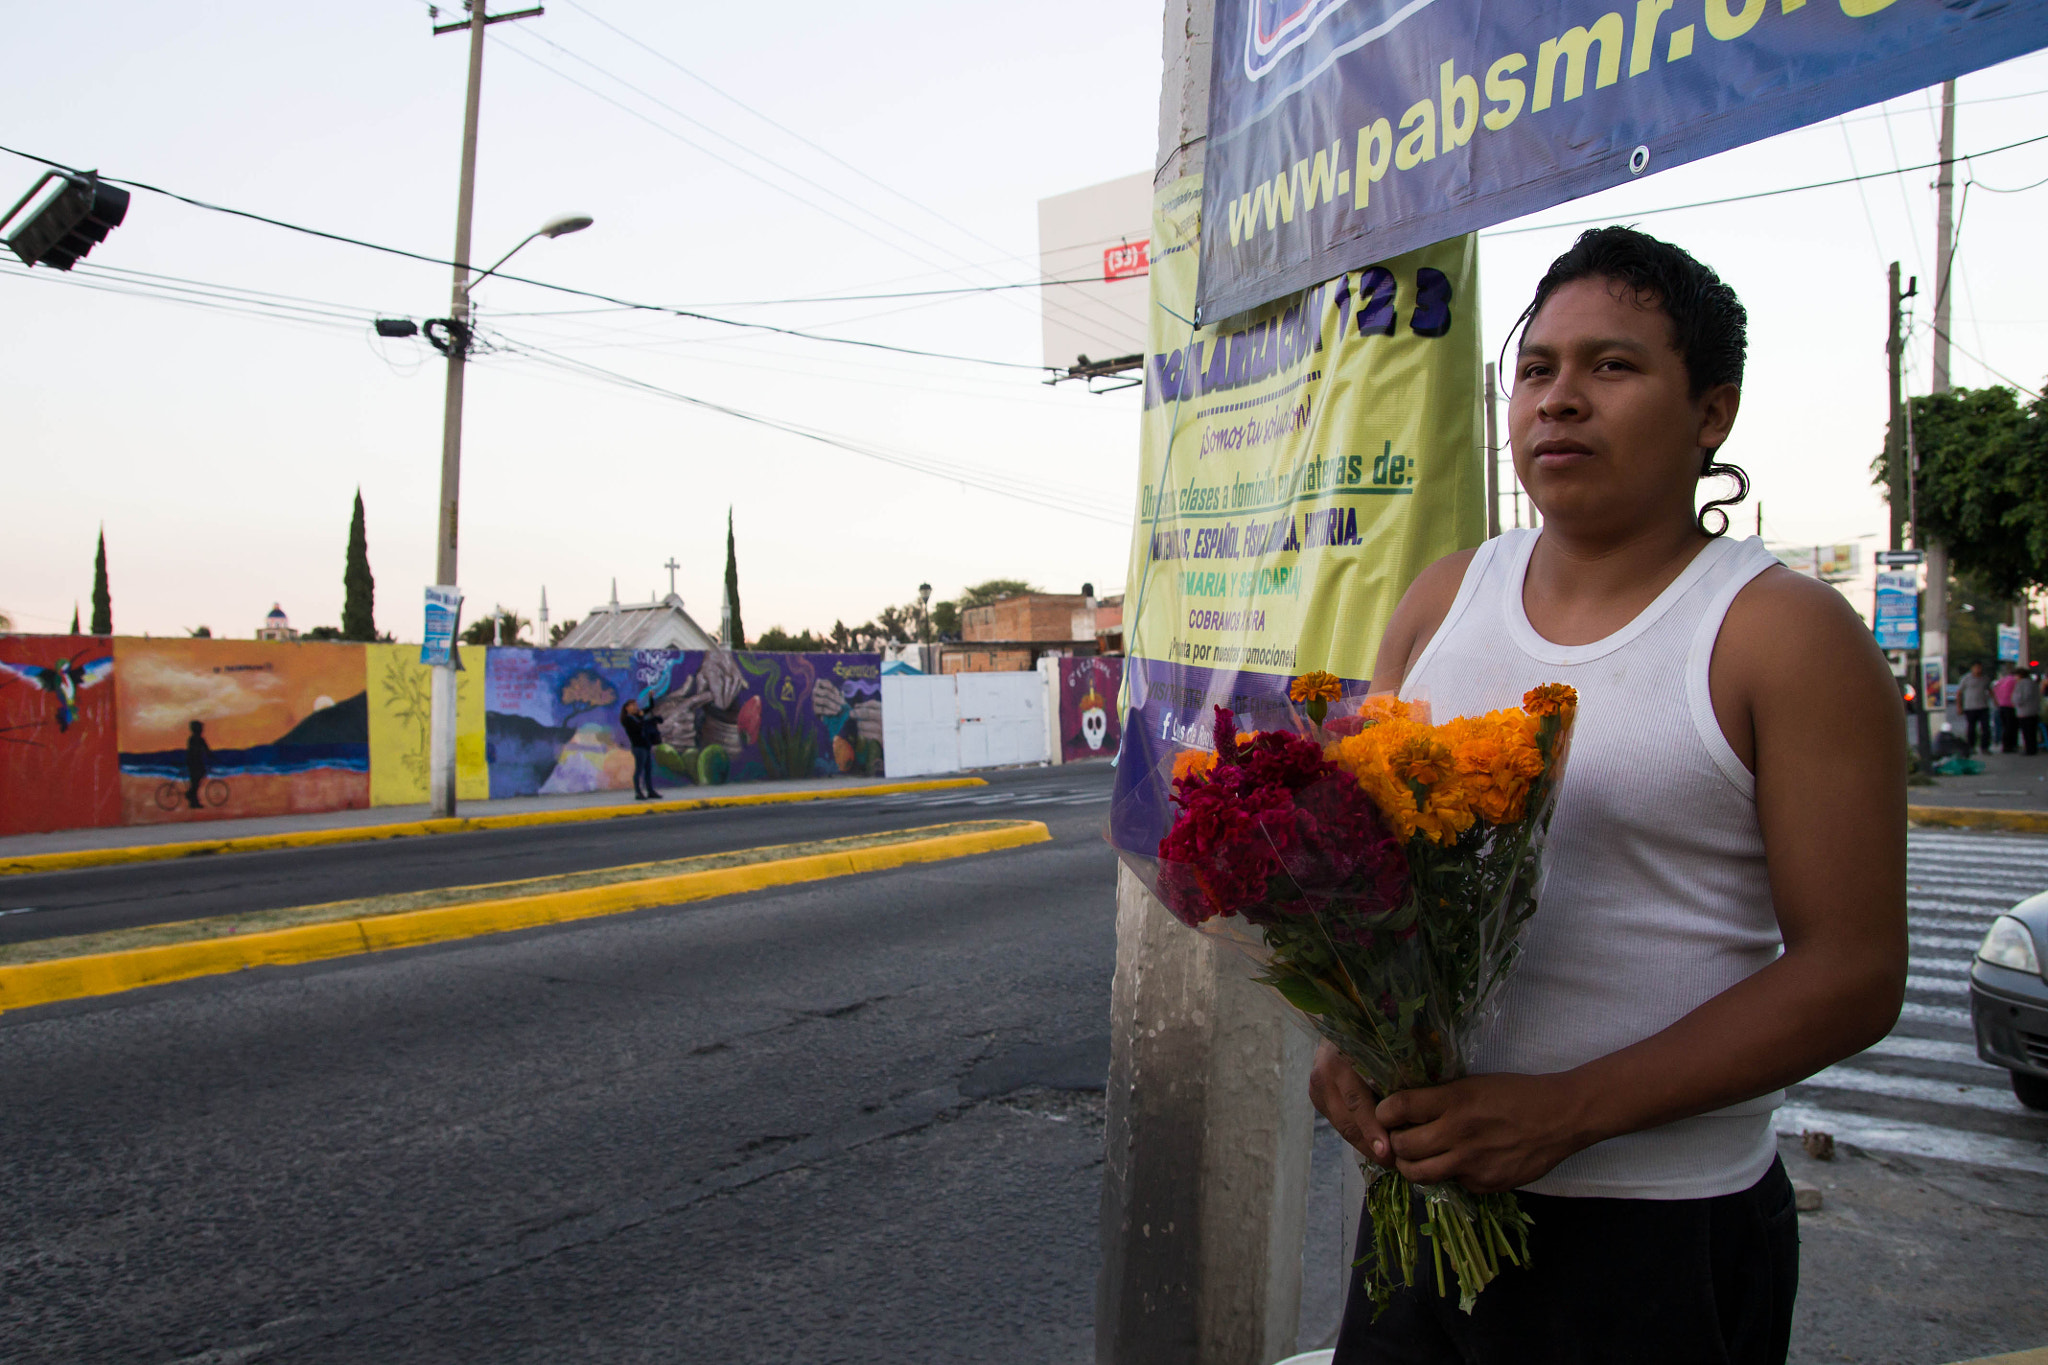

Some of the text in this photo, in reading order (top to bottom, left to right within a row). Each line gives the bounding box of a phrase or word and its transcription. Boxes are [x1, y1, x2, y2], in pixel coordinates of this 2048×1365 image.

[1247, 416, 1263, 446] tu
[1179, 476, 1220, 510] clases
[1222, 485, 1229, 510] a
[1373, 440, 1414, 485] de:
[1193, 522, 1240, 561] ESPAÑOL,
[1231, 572, 1238, 598] Y
[1239, 565, 1302, 602] SENDARIA,
[1189, 609, 1240, 632] COBRAMOS
[1193, 643, 1211, 665] por
